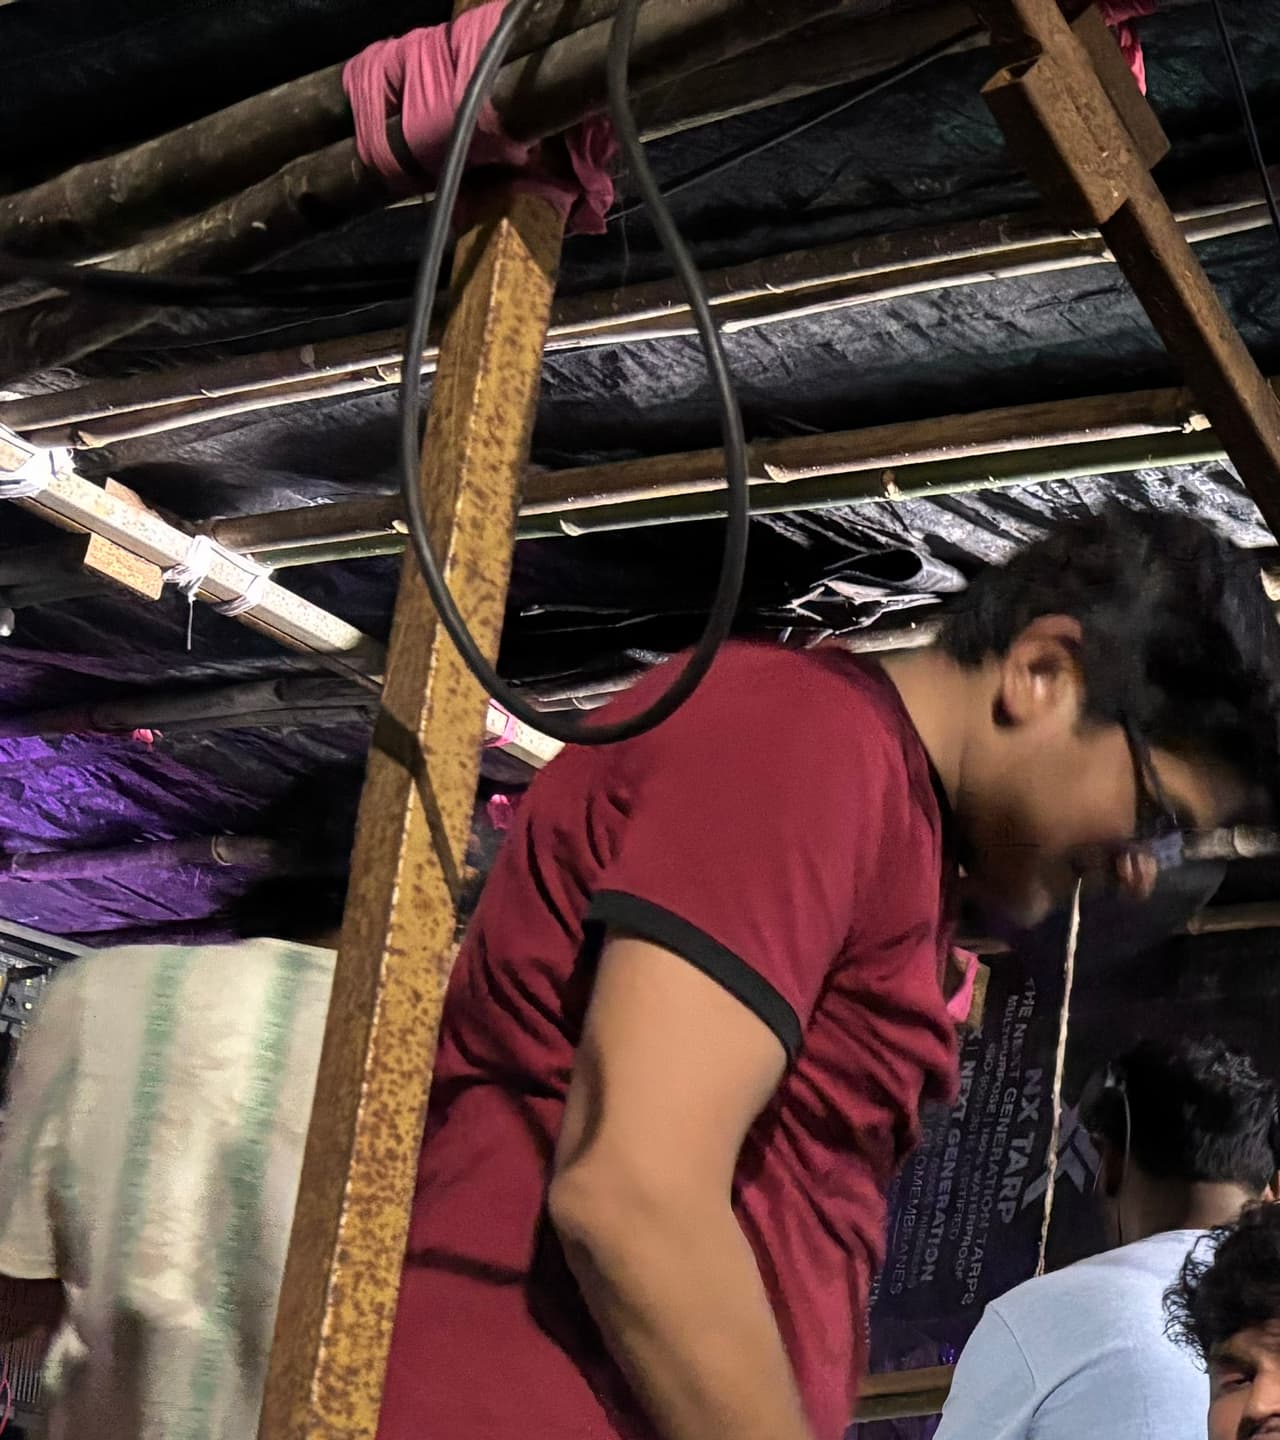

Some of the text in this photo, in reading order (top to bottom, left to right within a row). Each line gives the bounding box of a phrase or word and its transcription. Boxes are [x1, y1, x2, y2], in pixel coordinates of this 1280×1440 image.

[920, 1128, 961, 1280] GENERATION
[979, 1087, 1018, 1228] GENERATION
[997, 1132, 1035, 1224] TARP
